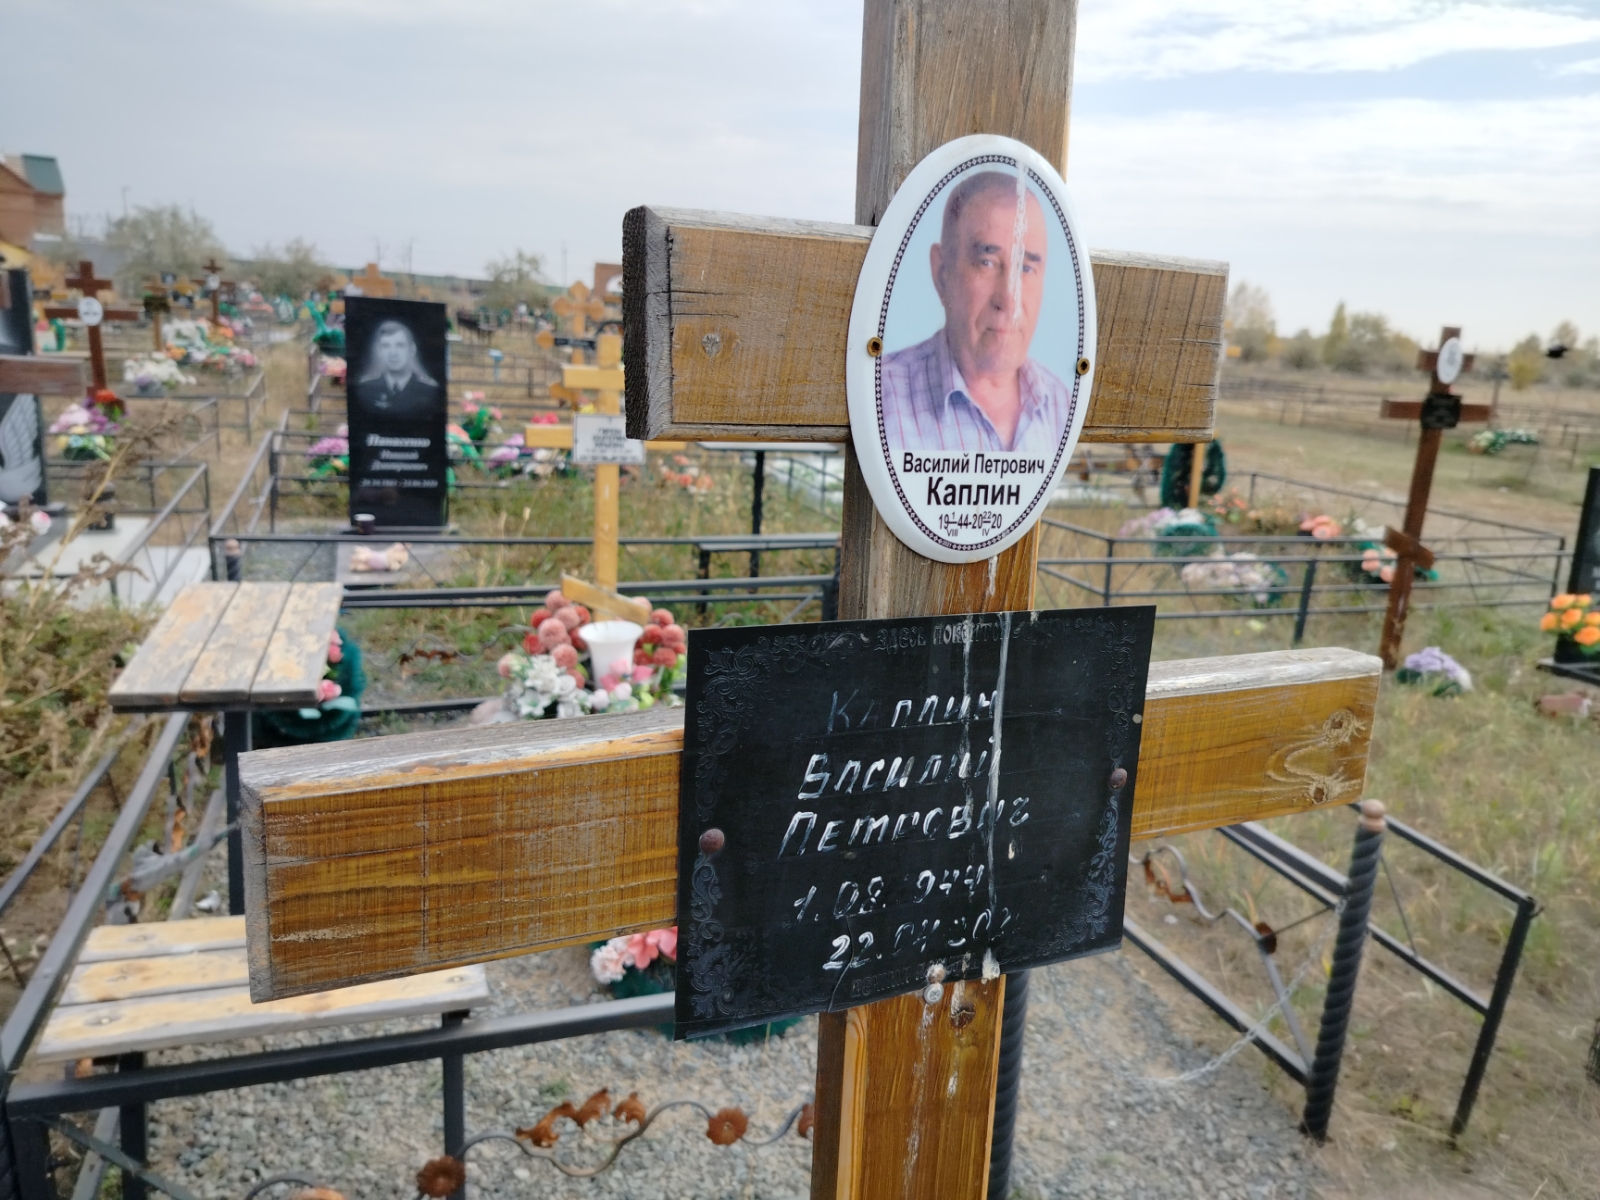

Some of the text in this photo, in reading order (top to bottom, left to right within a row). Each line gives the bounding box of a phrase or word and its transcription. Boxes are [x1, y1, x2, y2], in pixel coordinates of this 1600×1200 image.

[903, 452, 1045, 479] Василий Петрович
[927, 476, 1021, 506] Каплин
